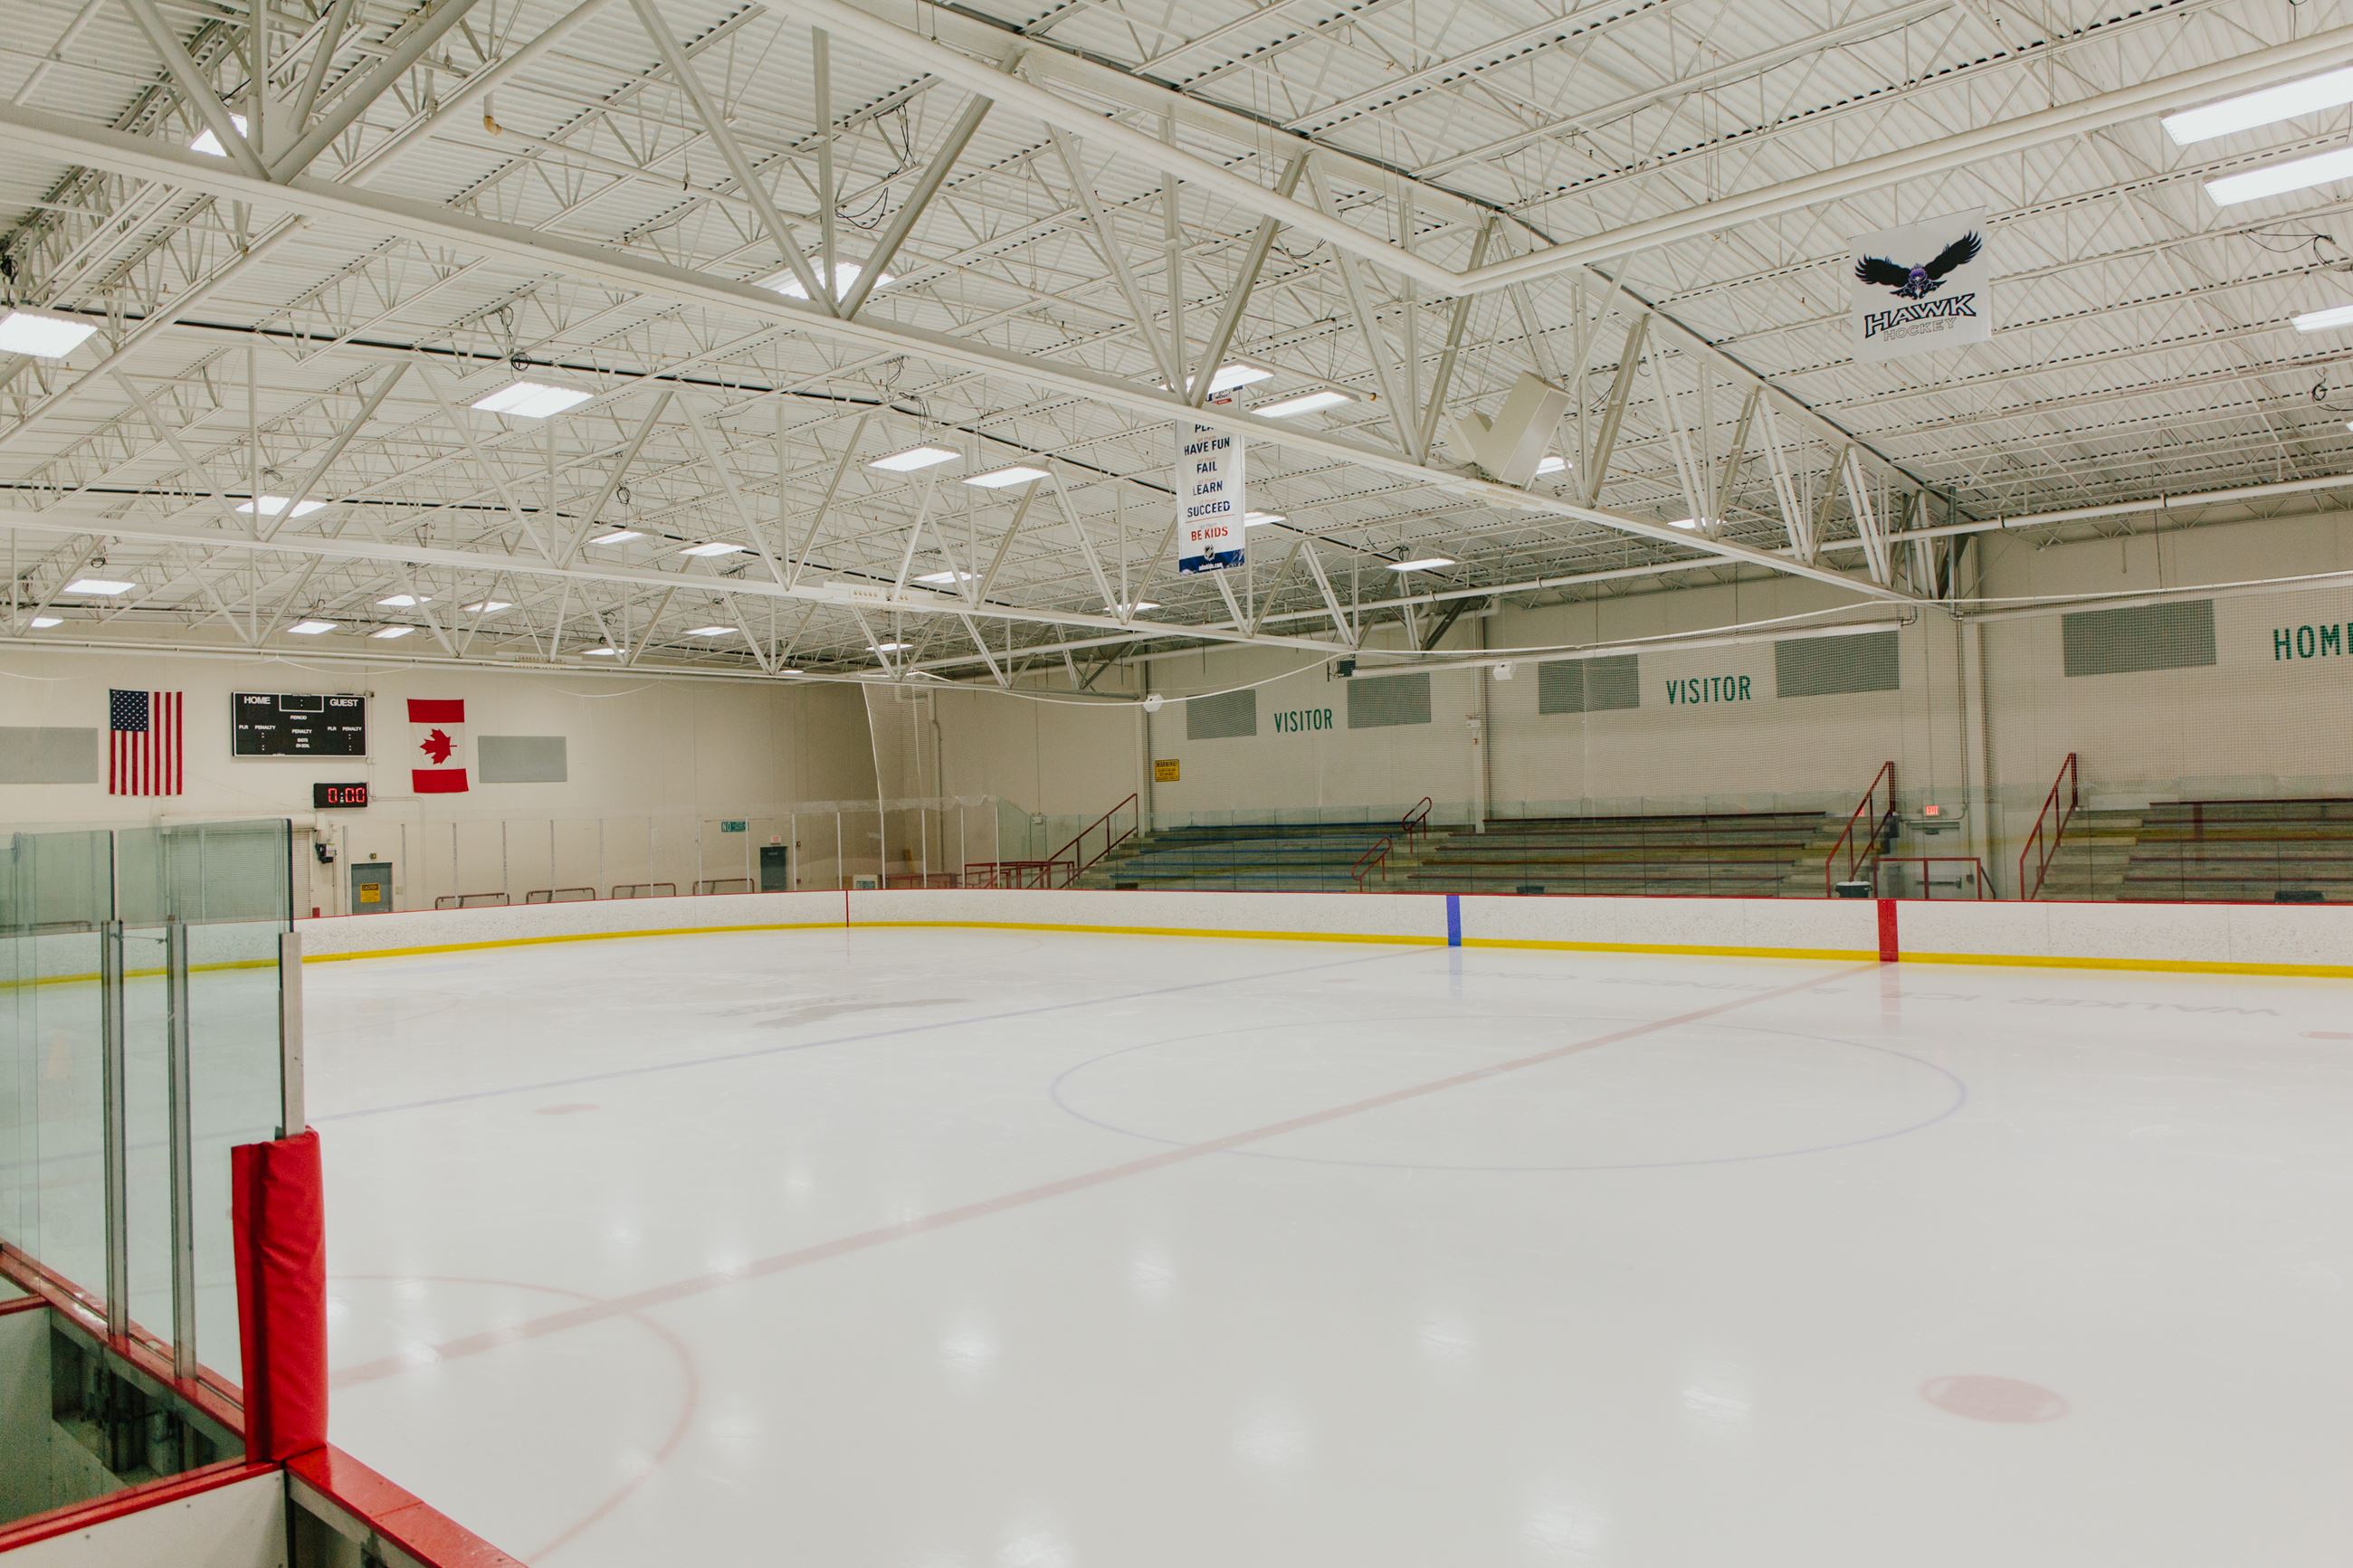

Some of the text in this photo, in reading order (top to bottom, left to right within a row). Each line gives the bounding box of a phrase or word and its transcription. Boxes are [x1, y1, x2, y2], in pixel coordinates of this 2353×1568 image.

[1864, 293, 1977, 338] HAWK
[1883, 318, 1957, 341] HOCKEY
[1184, 437, 1230, 456] HAVE FUN
[1196, 461, 1217, 474] FAIL
[1193, 480, 1223, 496] LEARN
[1187, 500, 1230, 518] SUCCEED
[1191, 527, 1228, 541] BE KIDS
[1666, 675, 1751, 705] VISITOR
[243, 696, 271, 705] HOME
[329, 698, 358, 707] GUEST
[1274, 708, 1332, 733] VISITOR
[328, 787, 366, 803] 0:00
[2007, 996, 2280, 1016] WALKER
